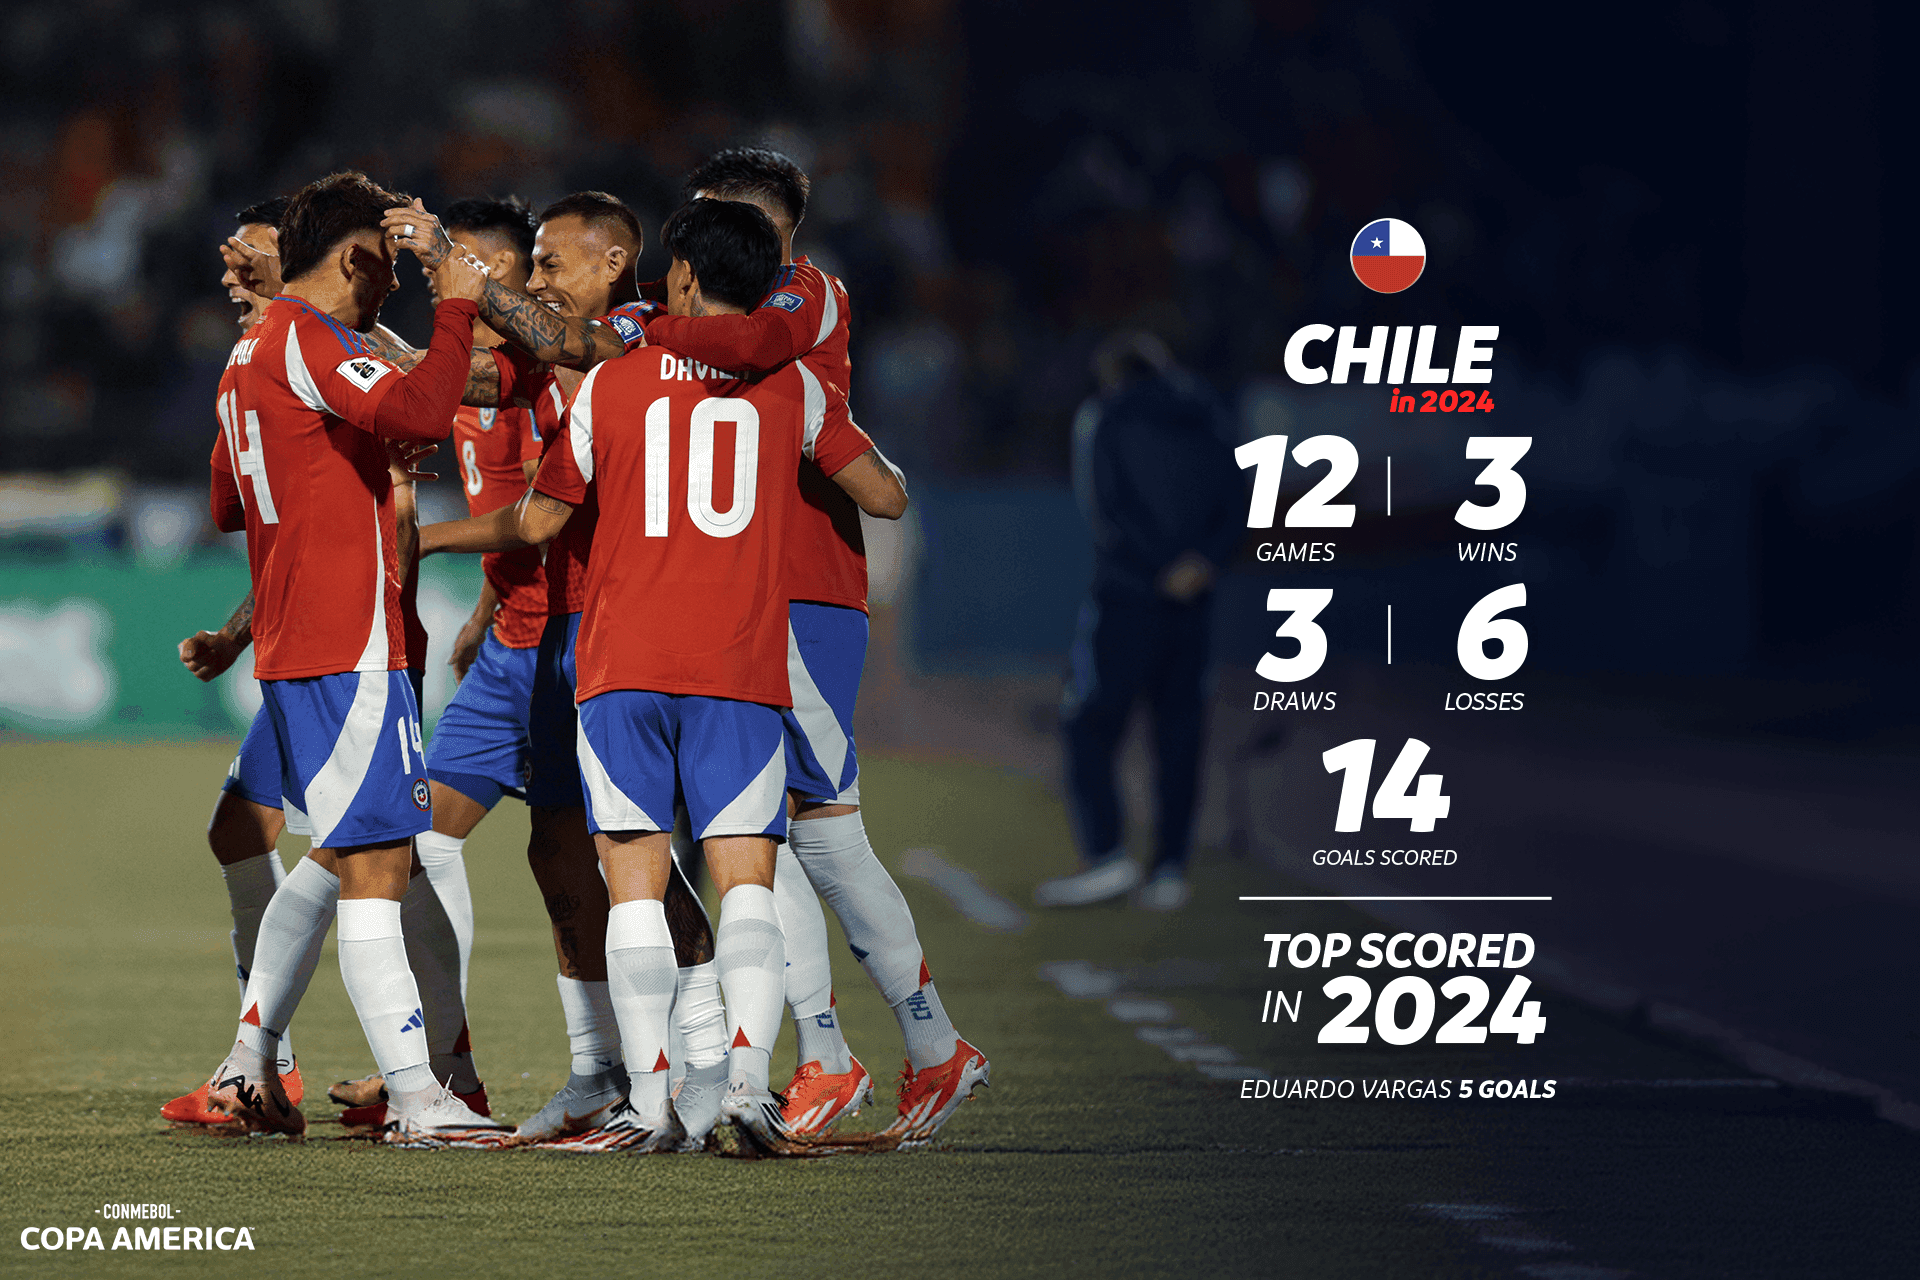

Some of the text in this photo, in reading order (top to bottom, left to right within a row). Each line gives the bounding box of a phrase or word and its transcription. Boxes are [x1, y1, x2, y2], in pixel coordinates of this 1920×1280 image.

[218, 388, 280, 525] 14
[462, 440, 483, 496] 8
[644, 396, 760, 539] 10
[397, 714, 427, 775] 14
